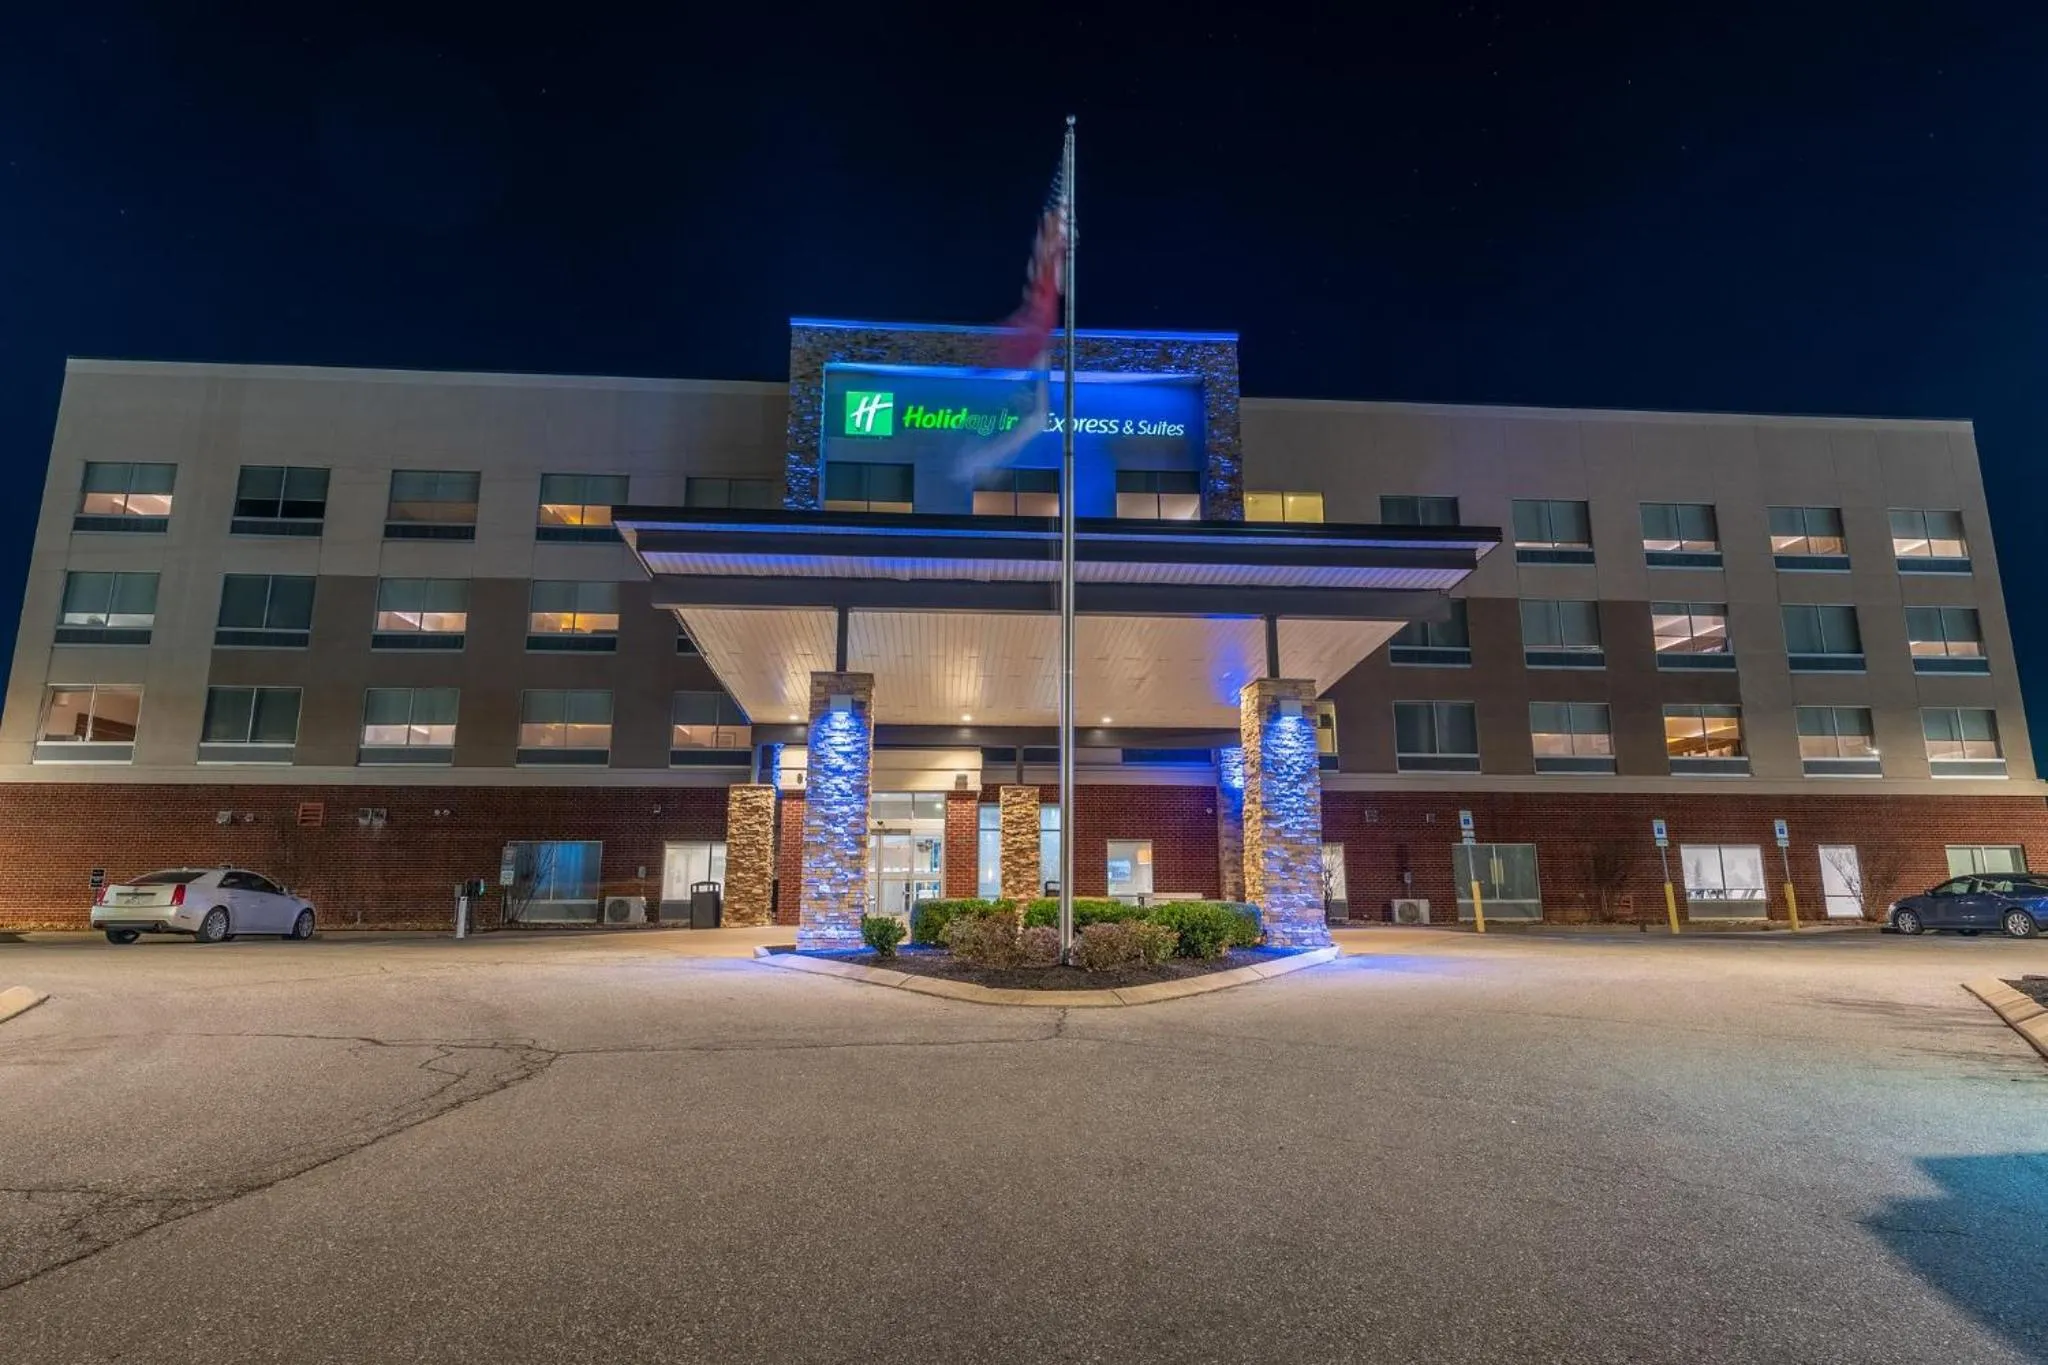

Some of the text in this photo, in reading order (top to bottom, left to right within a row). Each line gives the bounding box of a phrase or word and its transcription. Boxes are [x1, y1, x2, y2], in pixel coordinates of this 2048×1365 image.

[903, 405, 997, 436] Holiday
[1122, 419, 1134, 435] &
[1137, 419, 1185, 436] Suites
